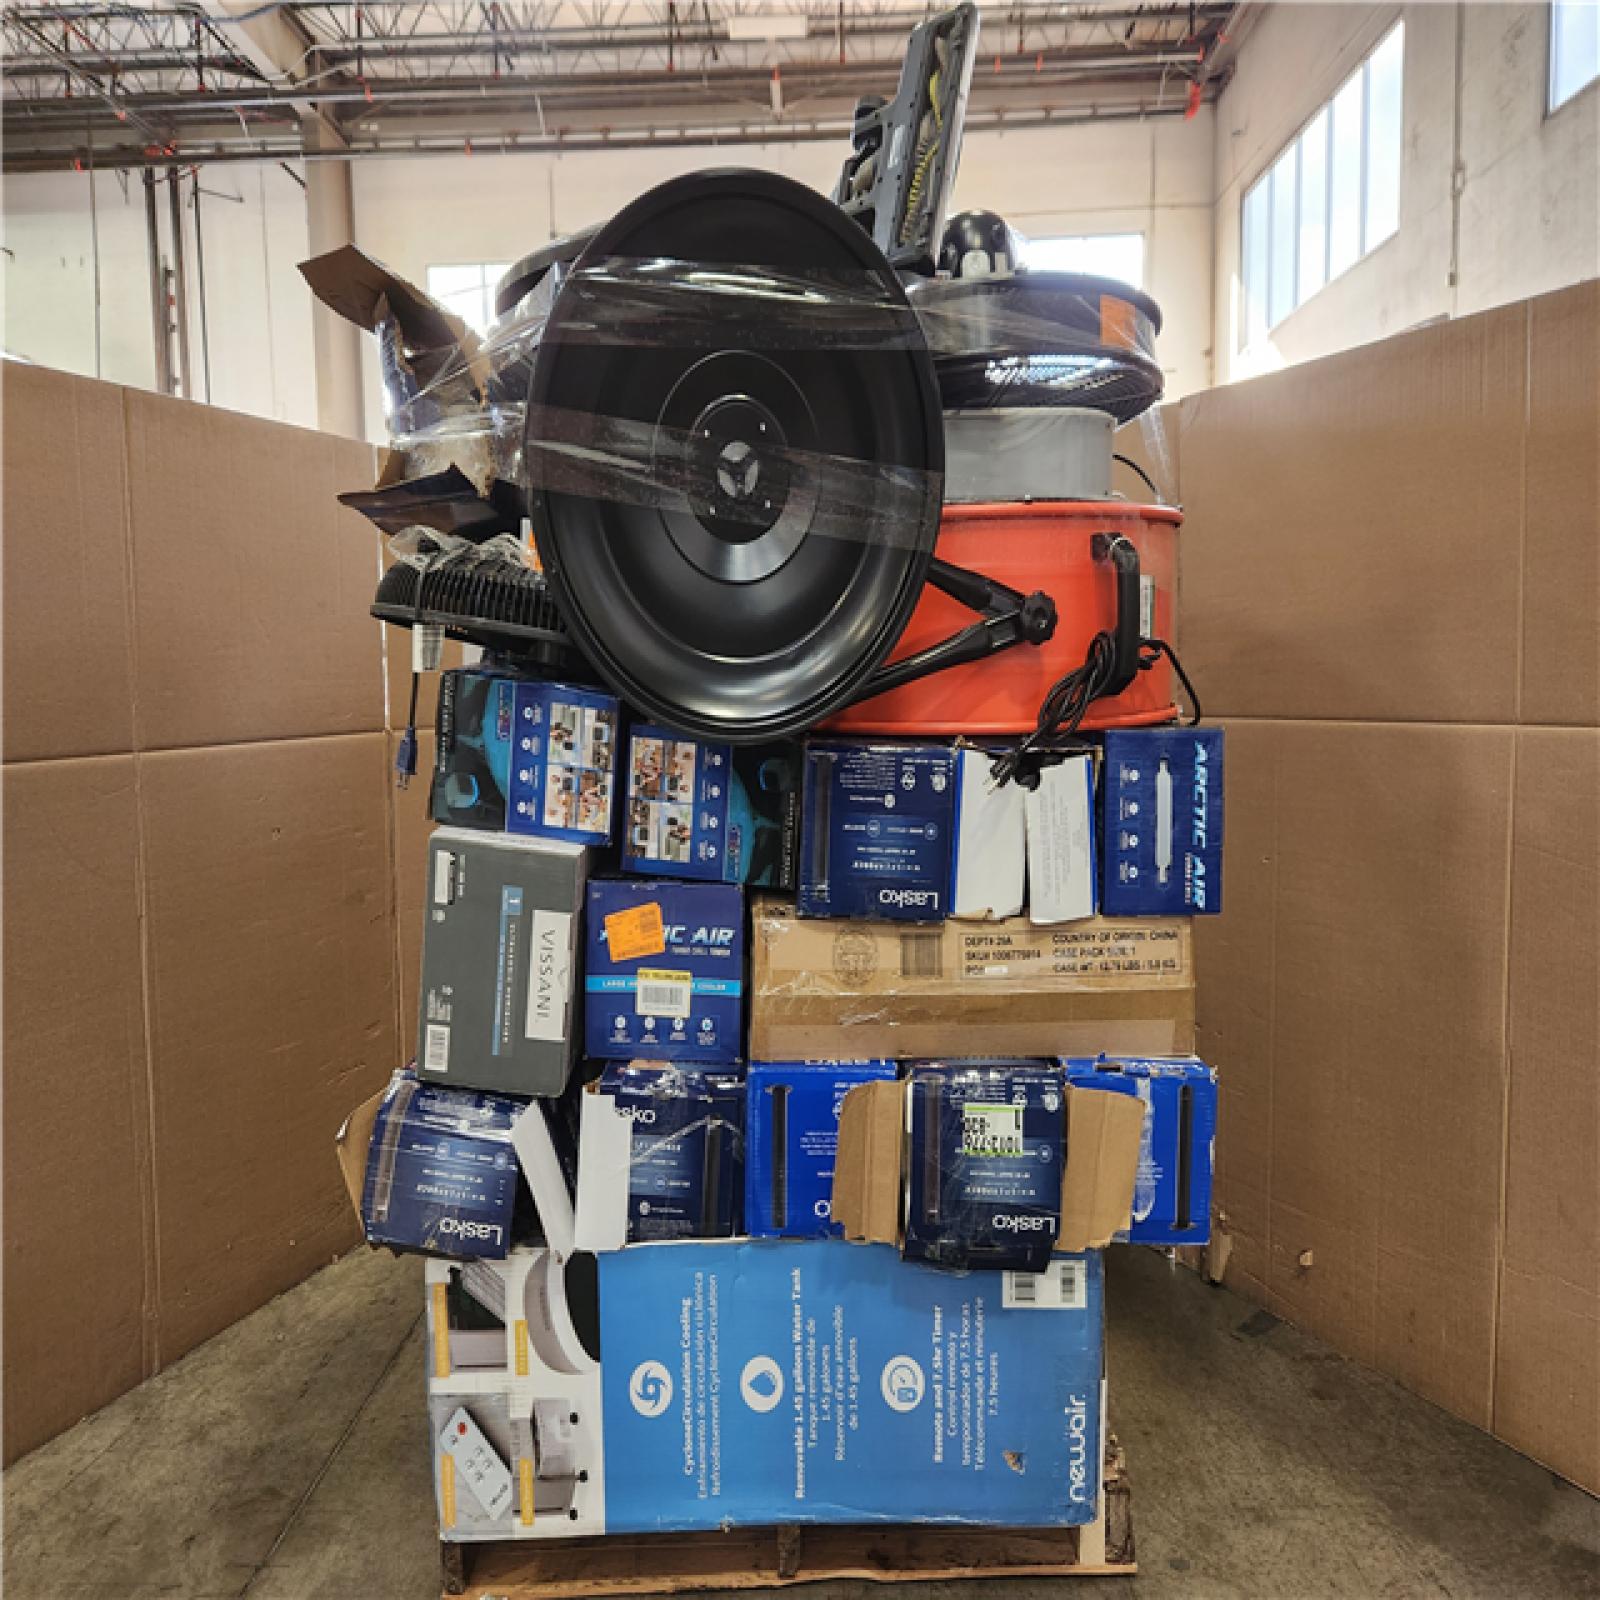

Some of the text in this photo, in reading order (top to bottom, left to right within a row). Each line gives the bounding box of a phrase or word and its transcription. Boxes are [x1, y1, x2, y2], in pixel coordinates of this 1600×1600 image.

[1191, 741, 1209, 910] ARCTIC AIR
[879, 890, 938, 910] Lasko
[690, 926, 736, 946] AIR
[537, 930, 556, 1018] VISSANI
[440, 1217, 502, 1246] Lasko
[992, 1214, 1056, 1236] Lasko
[833, 1305, 844, 1363] amovible
[933, 1305, 942, 1343] Timer
[961, 1342, 970, 1358] 7.5
[680, 1298, 694, 1475] CycloneCirculation Cooling
[791, 1267, 805, 1498] Removable 1.45 gallons Water Tank
[806, 1317, 818, 1448] Tanque removible de
[821, 1345, 832, 1421] 1.45 galones
[848, 1337, 859, 1430] de 1.45 gallons
[947, 1332, 957, 1436] Control remoto y
[961, 1365, 970, 1378] de
[974, 1360, 984, 1373] et
[988, 1352, 999, 1416] 7.5 heures
[934, 1384, 943, 1409] and
[961, 1382, 971, 1465] temporizador
[934, 1412, 944, 1463] Remote
